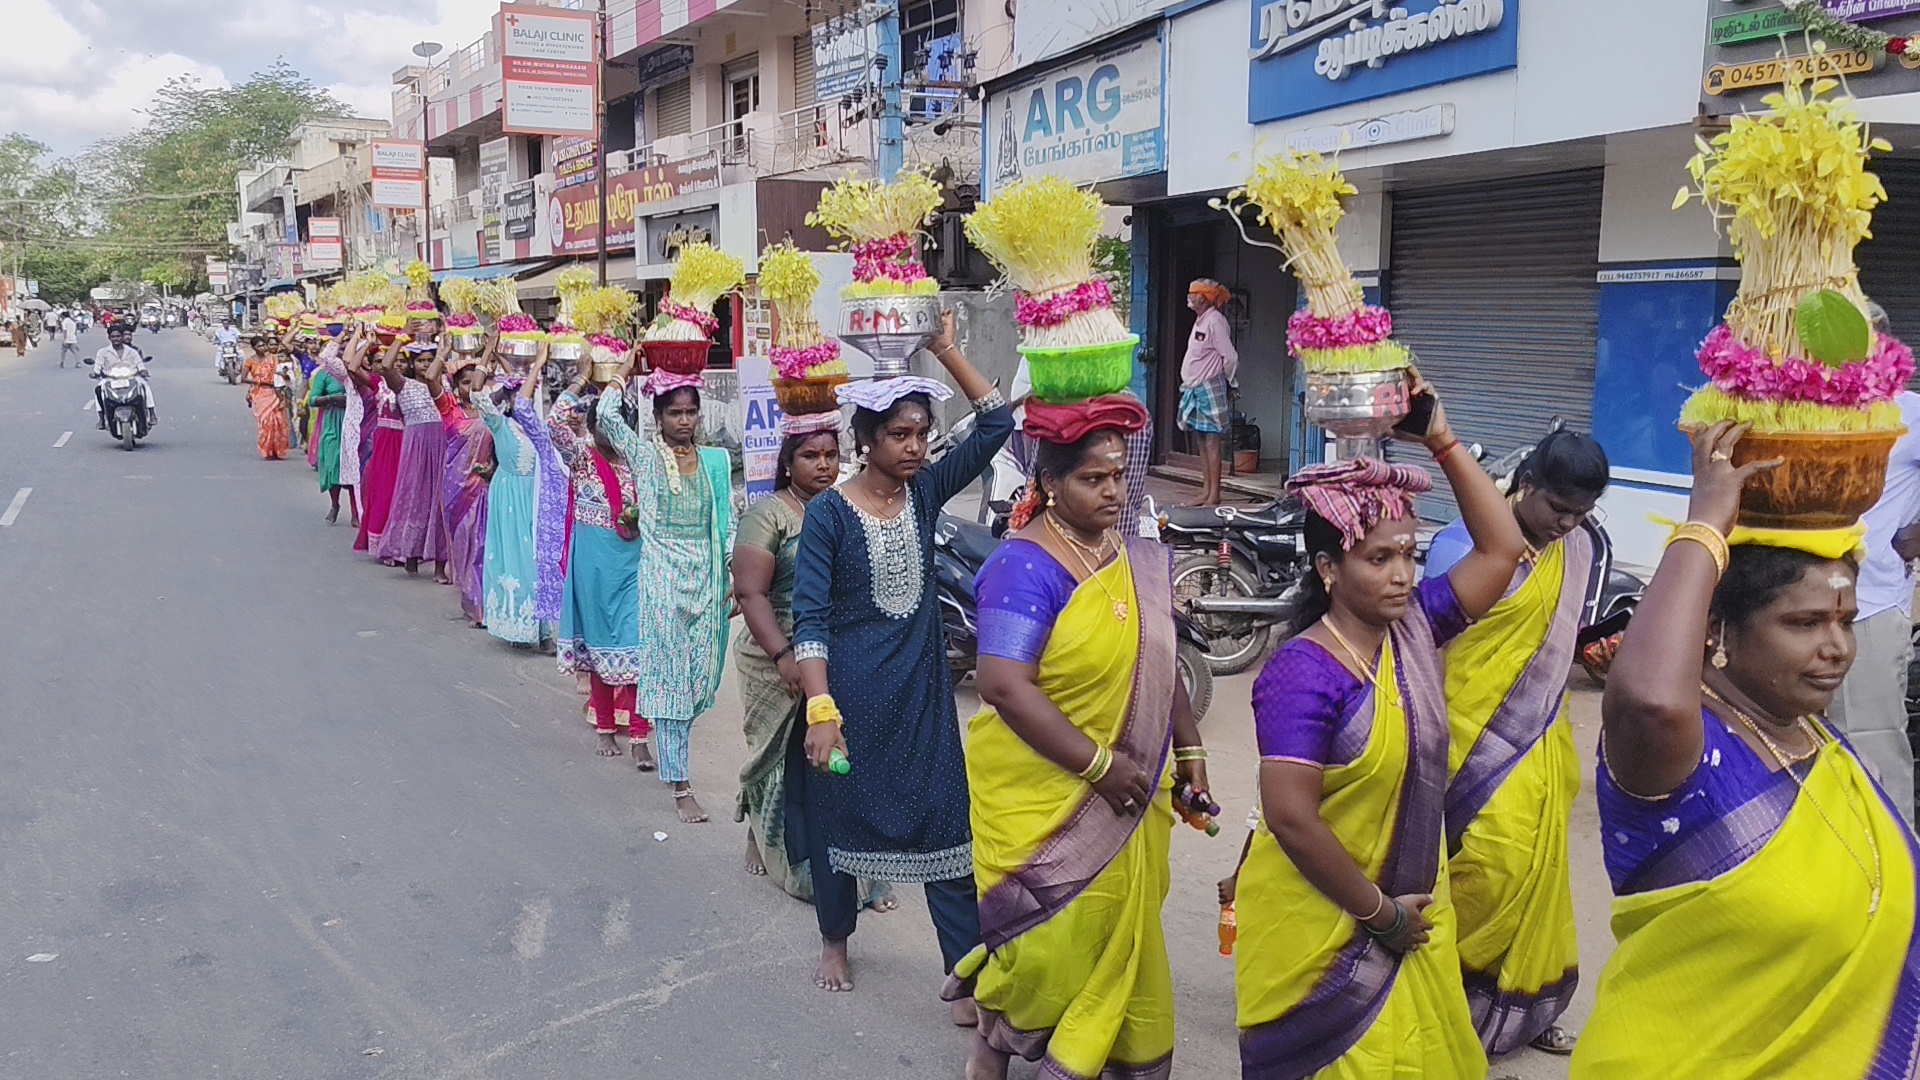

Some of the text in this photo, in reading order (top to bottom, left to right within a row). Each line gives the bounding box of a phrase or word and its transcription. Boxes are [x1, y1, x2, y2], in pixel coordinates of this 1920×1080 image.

[513, 28, 585, 43] BALAJI CLINIC
[1022, 63, 1122, 143] ARG
[1395, 114, 1438, 132] Clinic
[1023, 123, 1121, 168] பேங்கர்ஸ்
[745, 399, 784, 431] AR
